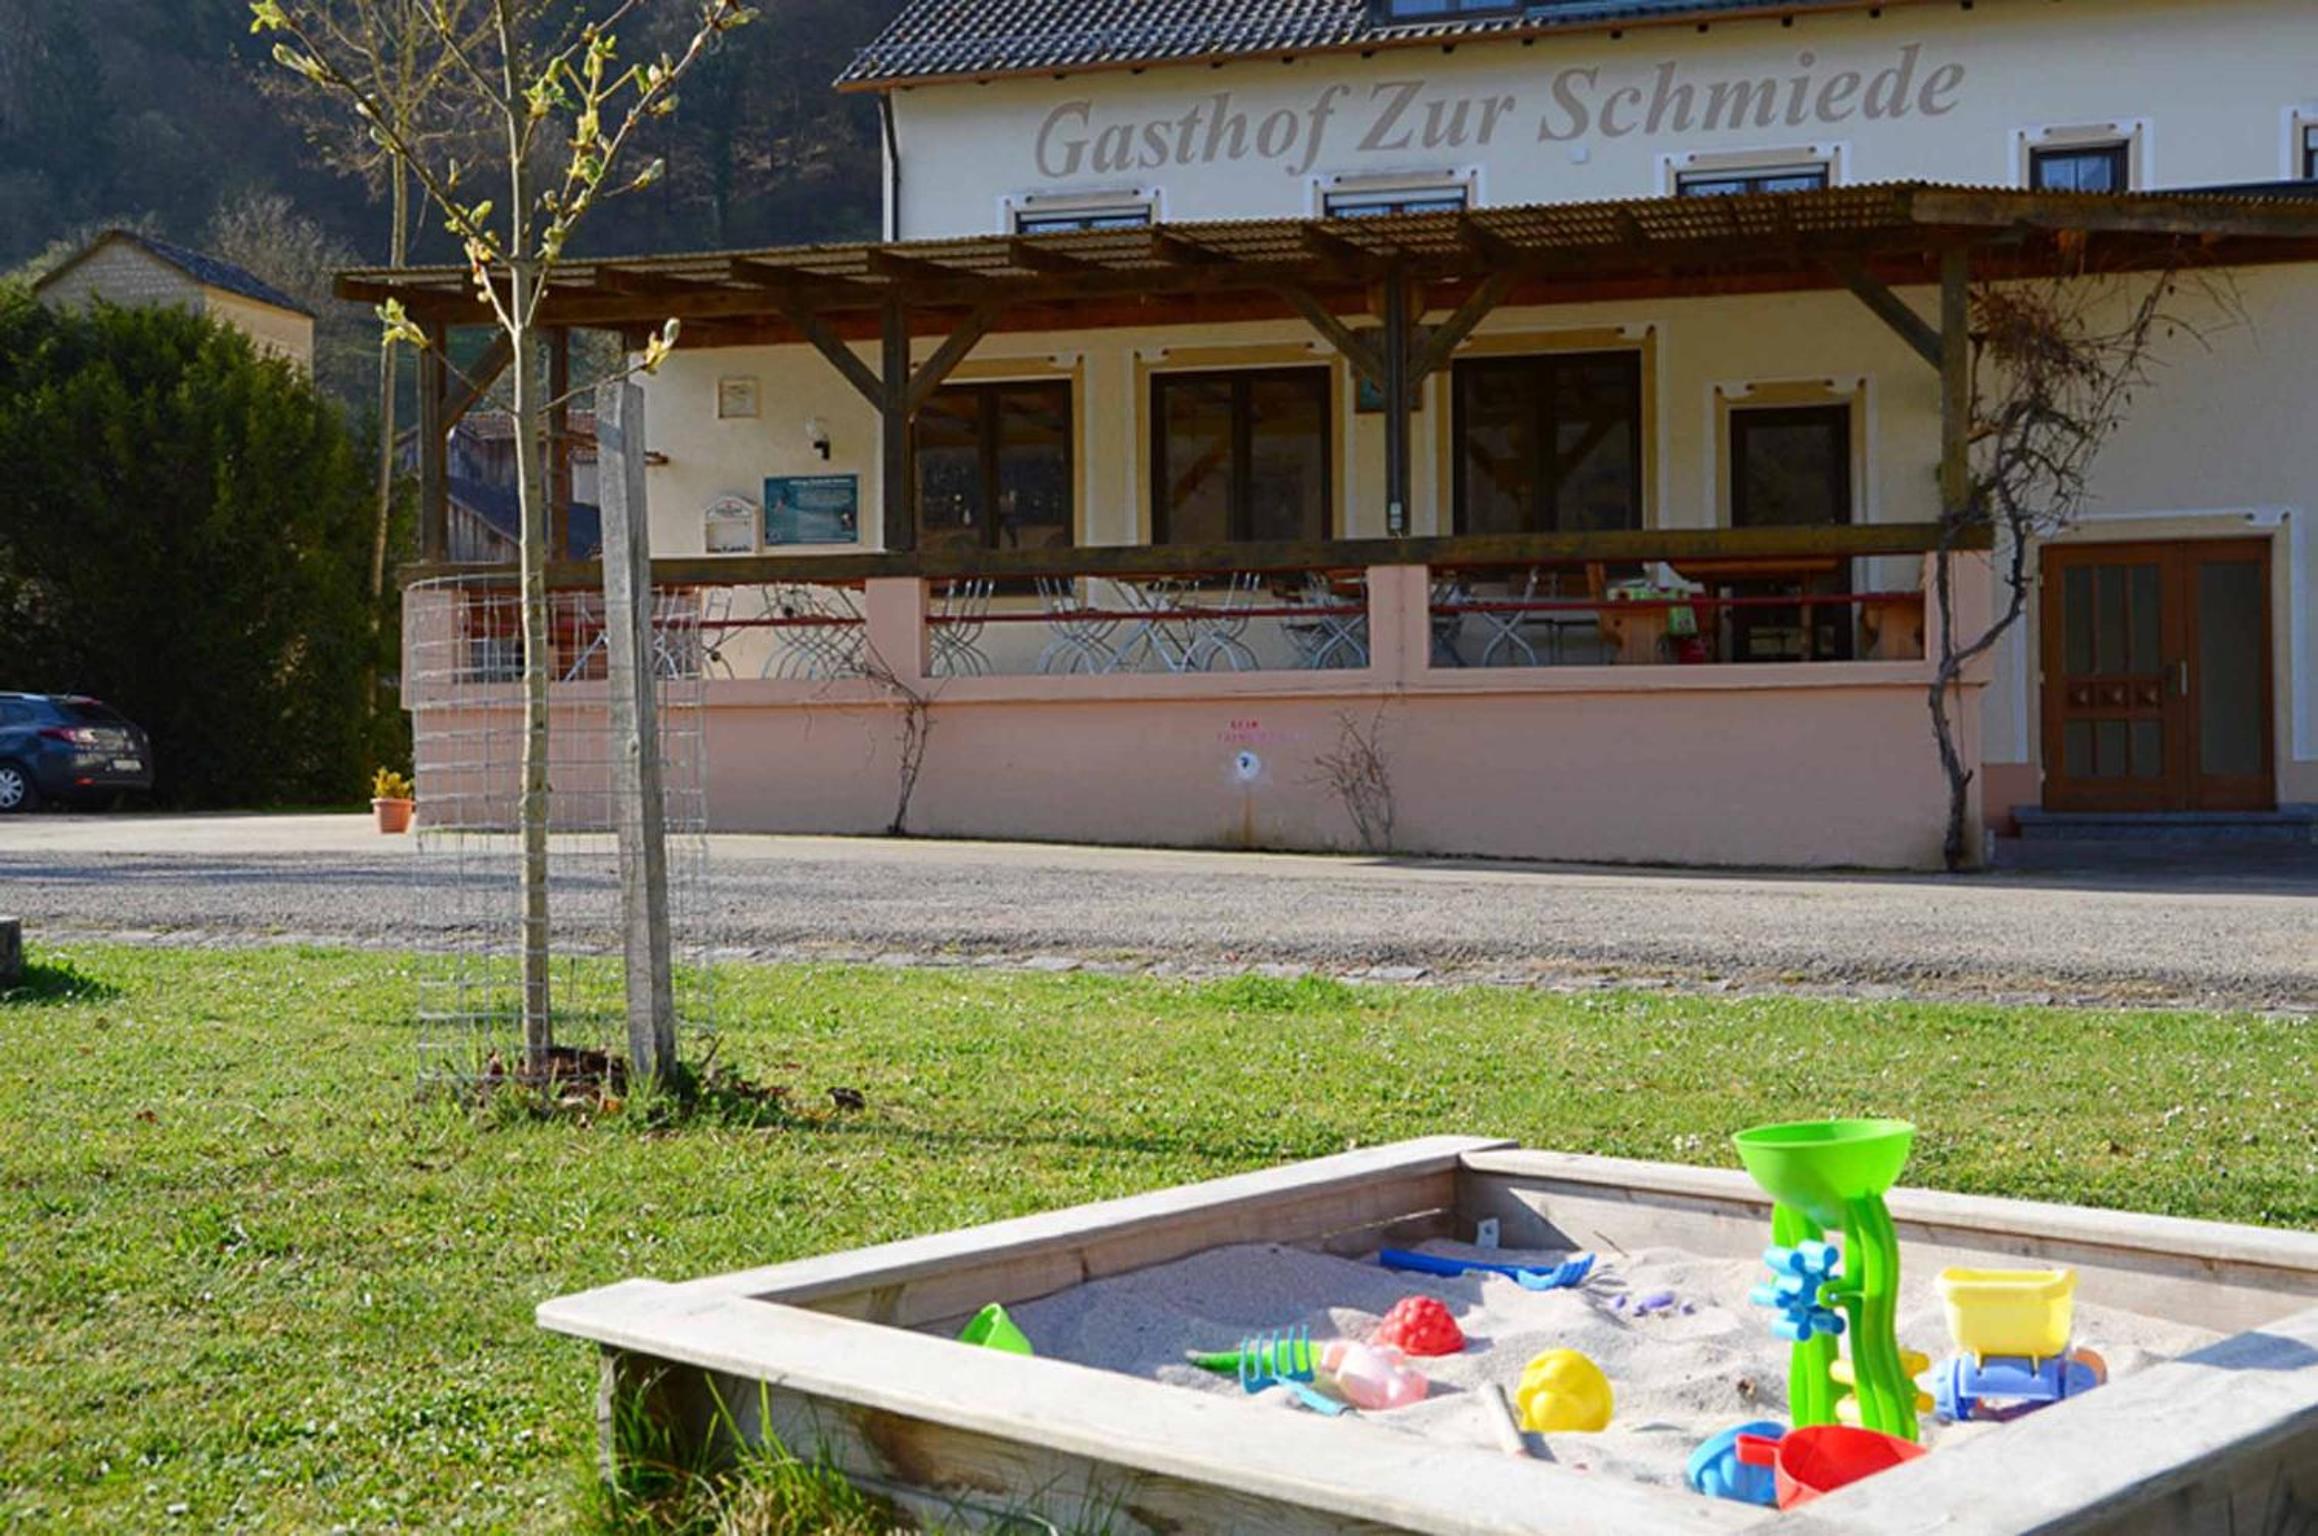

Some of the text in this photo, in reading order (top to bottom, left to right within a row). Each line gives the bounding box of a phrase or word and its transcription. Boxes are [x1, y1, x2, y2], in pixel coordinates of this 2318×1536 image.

[1035, 42, 1966, 178] Gasthof Zur Schmiede
